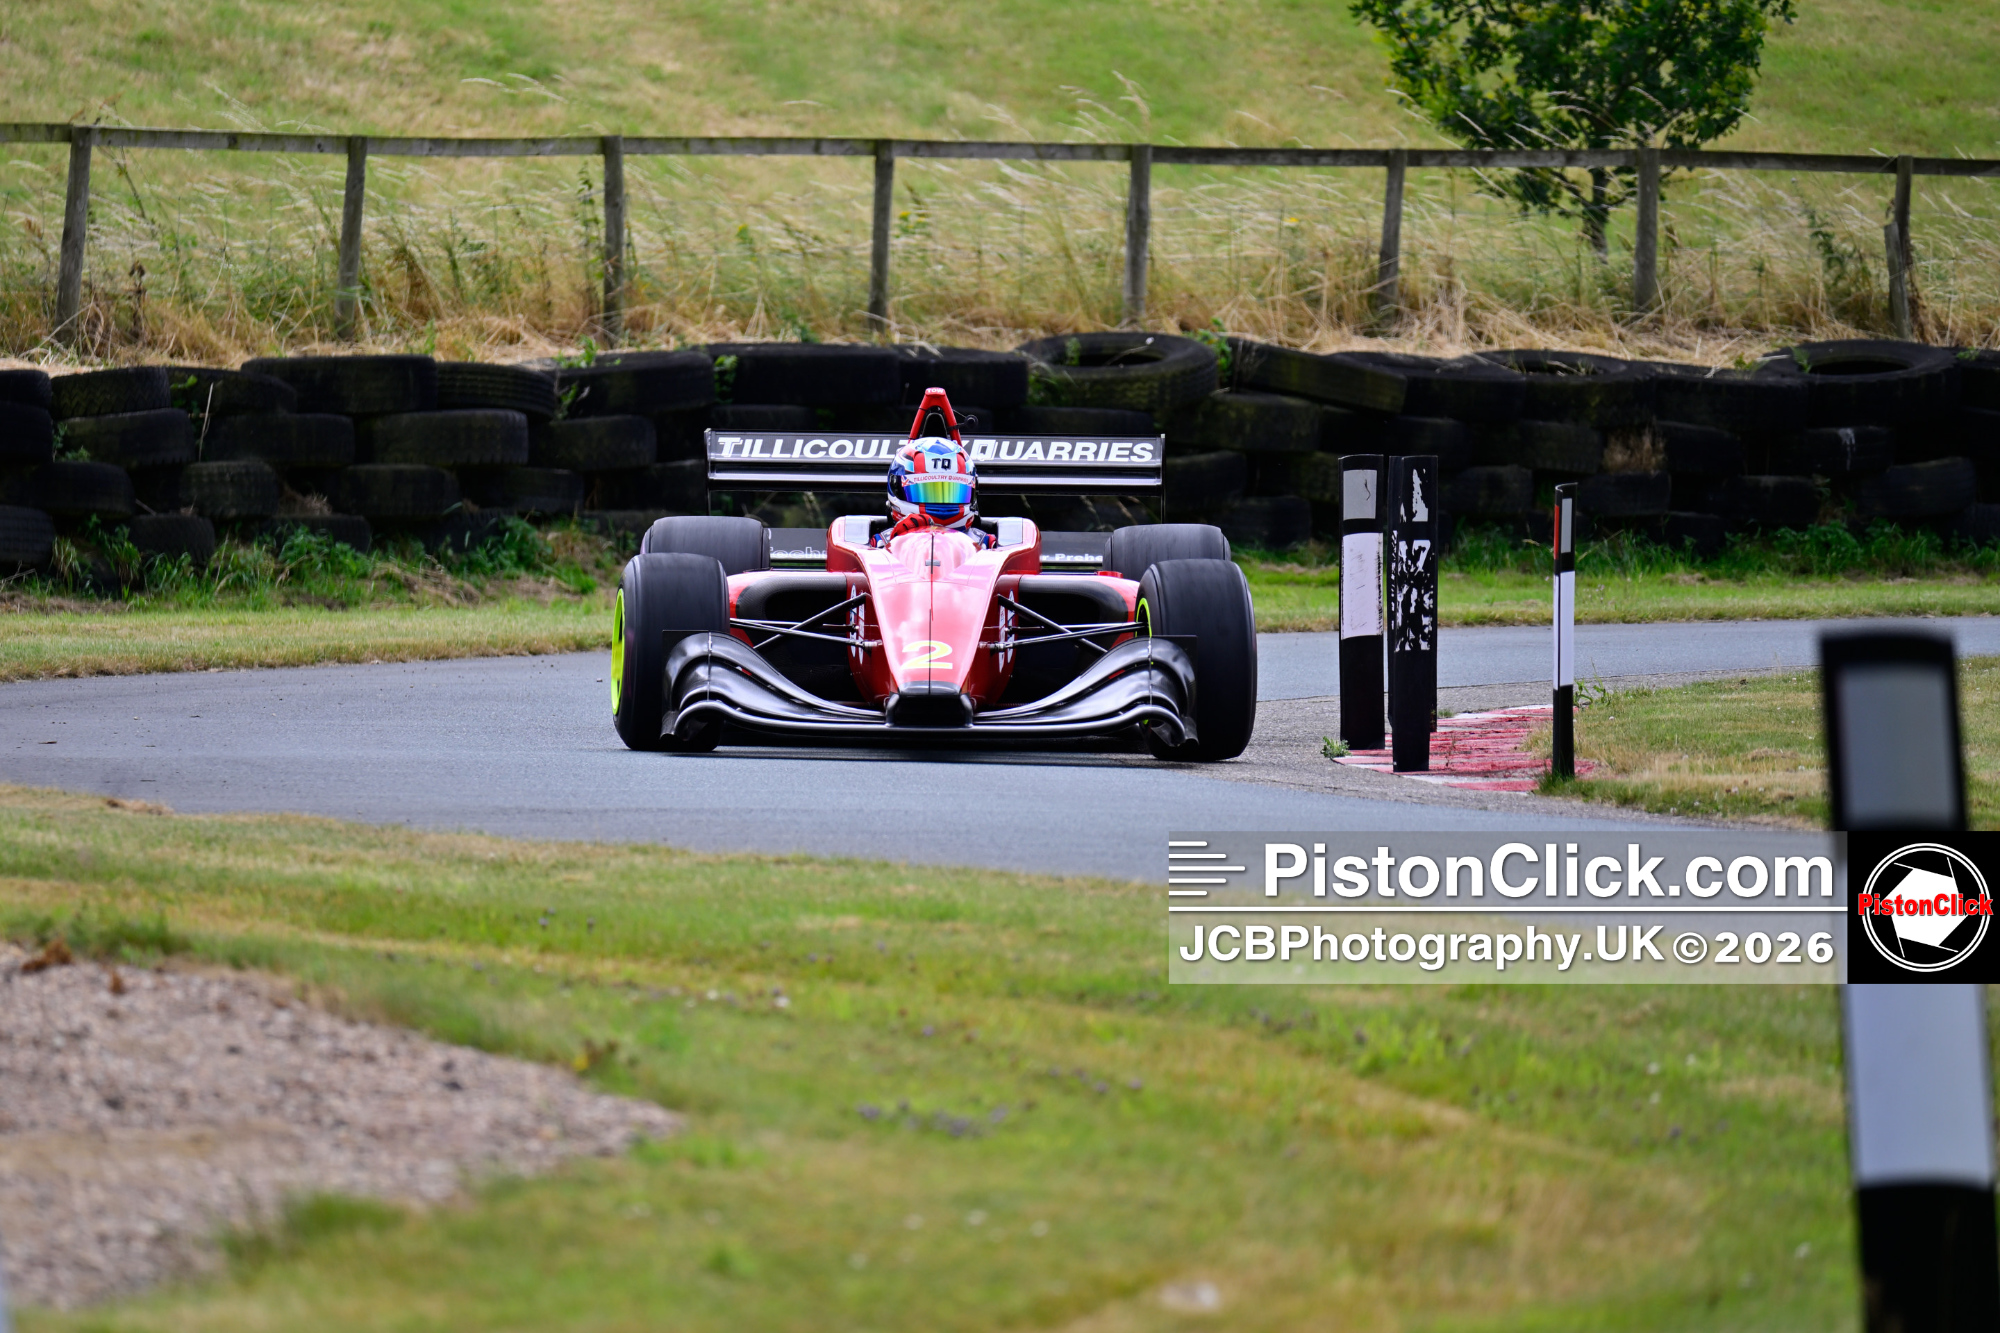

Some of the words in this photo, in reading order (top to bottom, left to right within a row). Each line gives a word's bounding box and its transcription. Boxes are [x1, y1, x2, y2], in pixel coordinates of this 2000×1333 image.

[718, 437, 969, 459] TILLICOUL
[970, 439, 1154, 462] QUARRIES
[931, 458, 951, 470] TQ
[901, 640, 953, 670] 2
